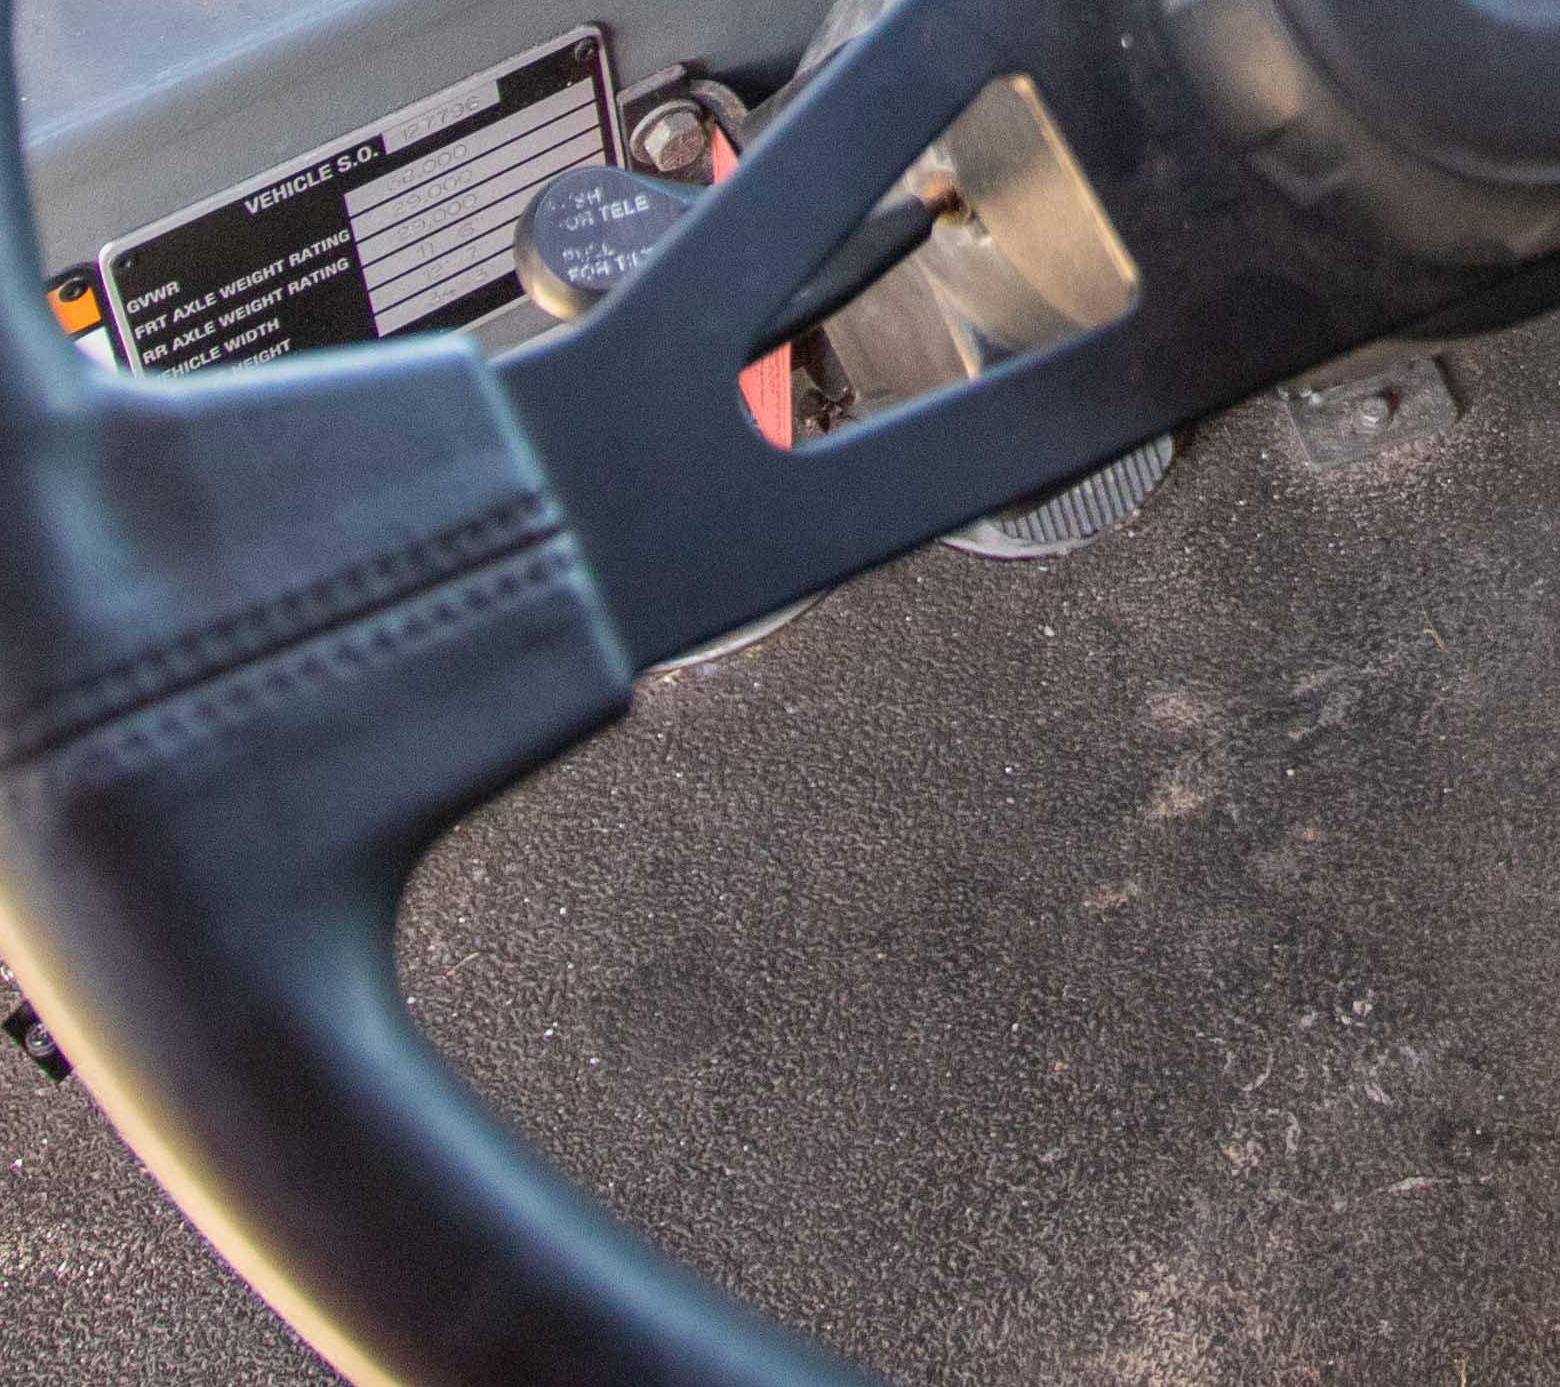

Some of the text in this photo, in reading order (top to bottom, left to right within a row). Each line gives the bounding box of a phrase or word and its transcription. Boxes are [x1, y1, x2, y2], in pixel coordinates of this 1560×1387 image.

[244, 164, 335, 217] VEHICLE
[337, 146, 379, 175] S.O.
[599, 194, 649, 221] TELE
[126, 280, 181, 314] GVWR
[134, 228, 351, 340] FRT AXLE WEIGHT RATING
[143, 258, 351, 366] RR AXLE WEIGHT RATING
[223, 318, 281, 353] WIDTH
